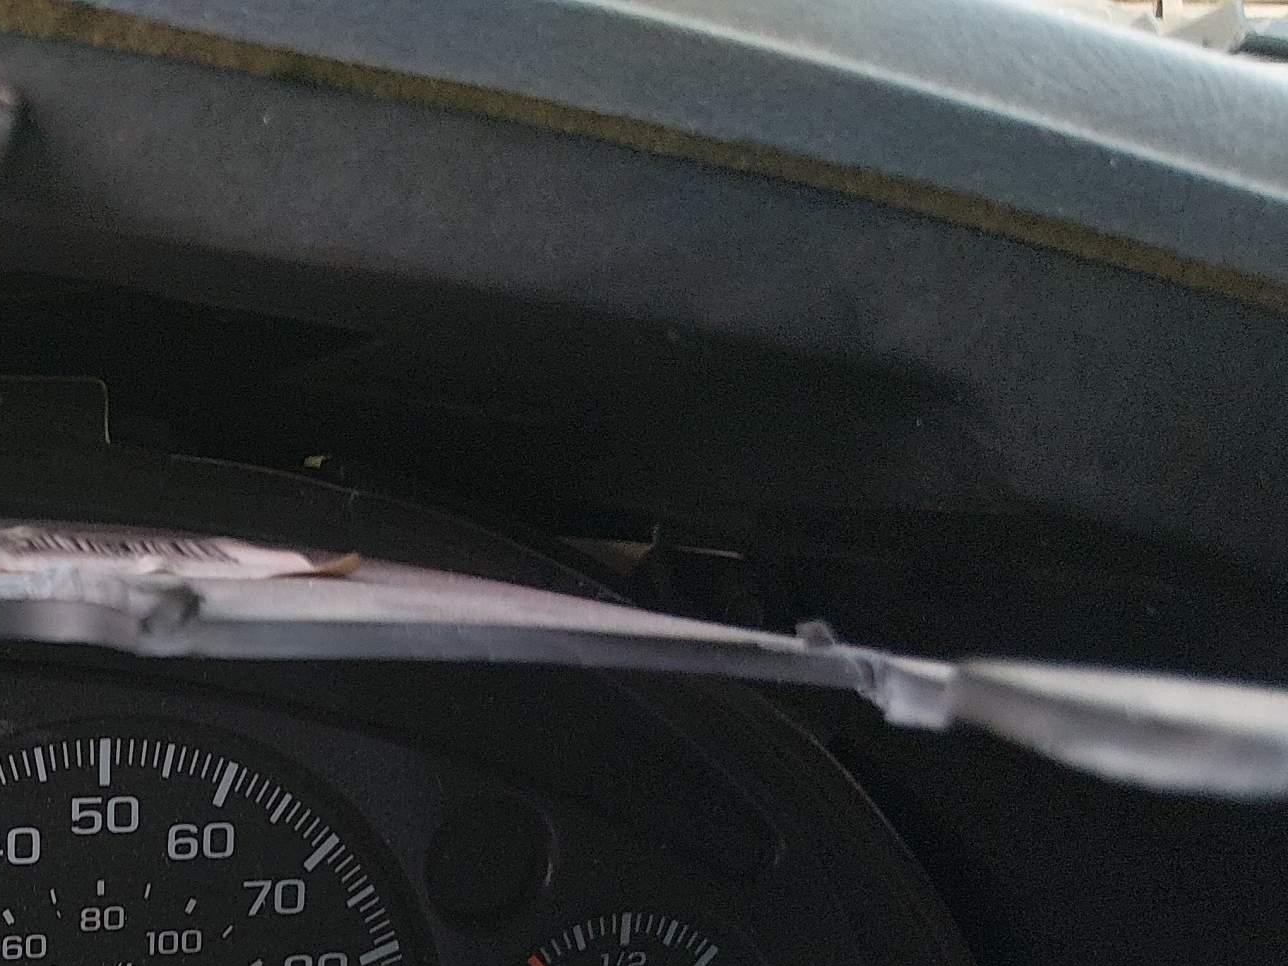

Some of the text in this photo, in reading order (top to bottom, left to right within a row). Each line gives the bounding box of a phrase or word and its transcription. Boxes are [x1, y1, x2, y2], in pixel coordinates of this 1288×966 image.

[71, 795, 140, 836] 50
[166, 821, 235, 861] 60
[242, 878, 306, 916] 70
[80, 905, 125, 932] 80
[1, 933, 47, 960] 60
[145, 929, 203, 956] 100
